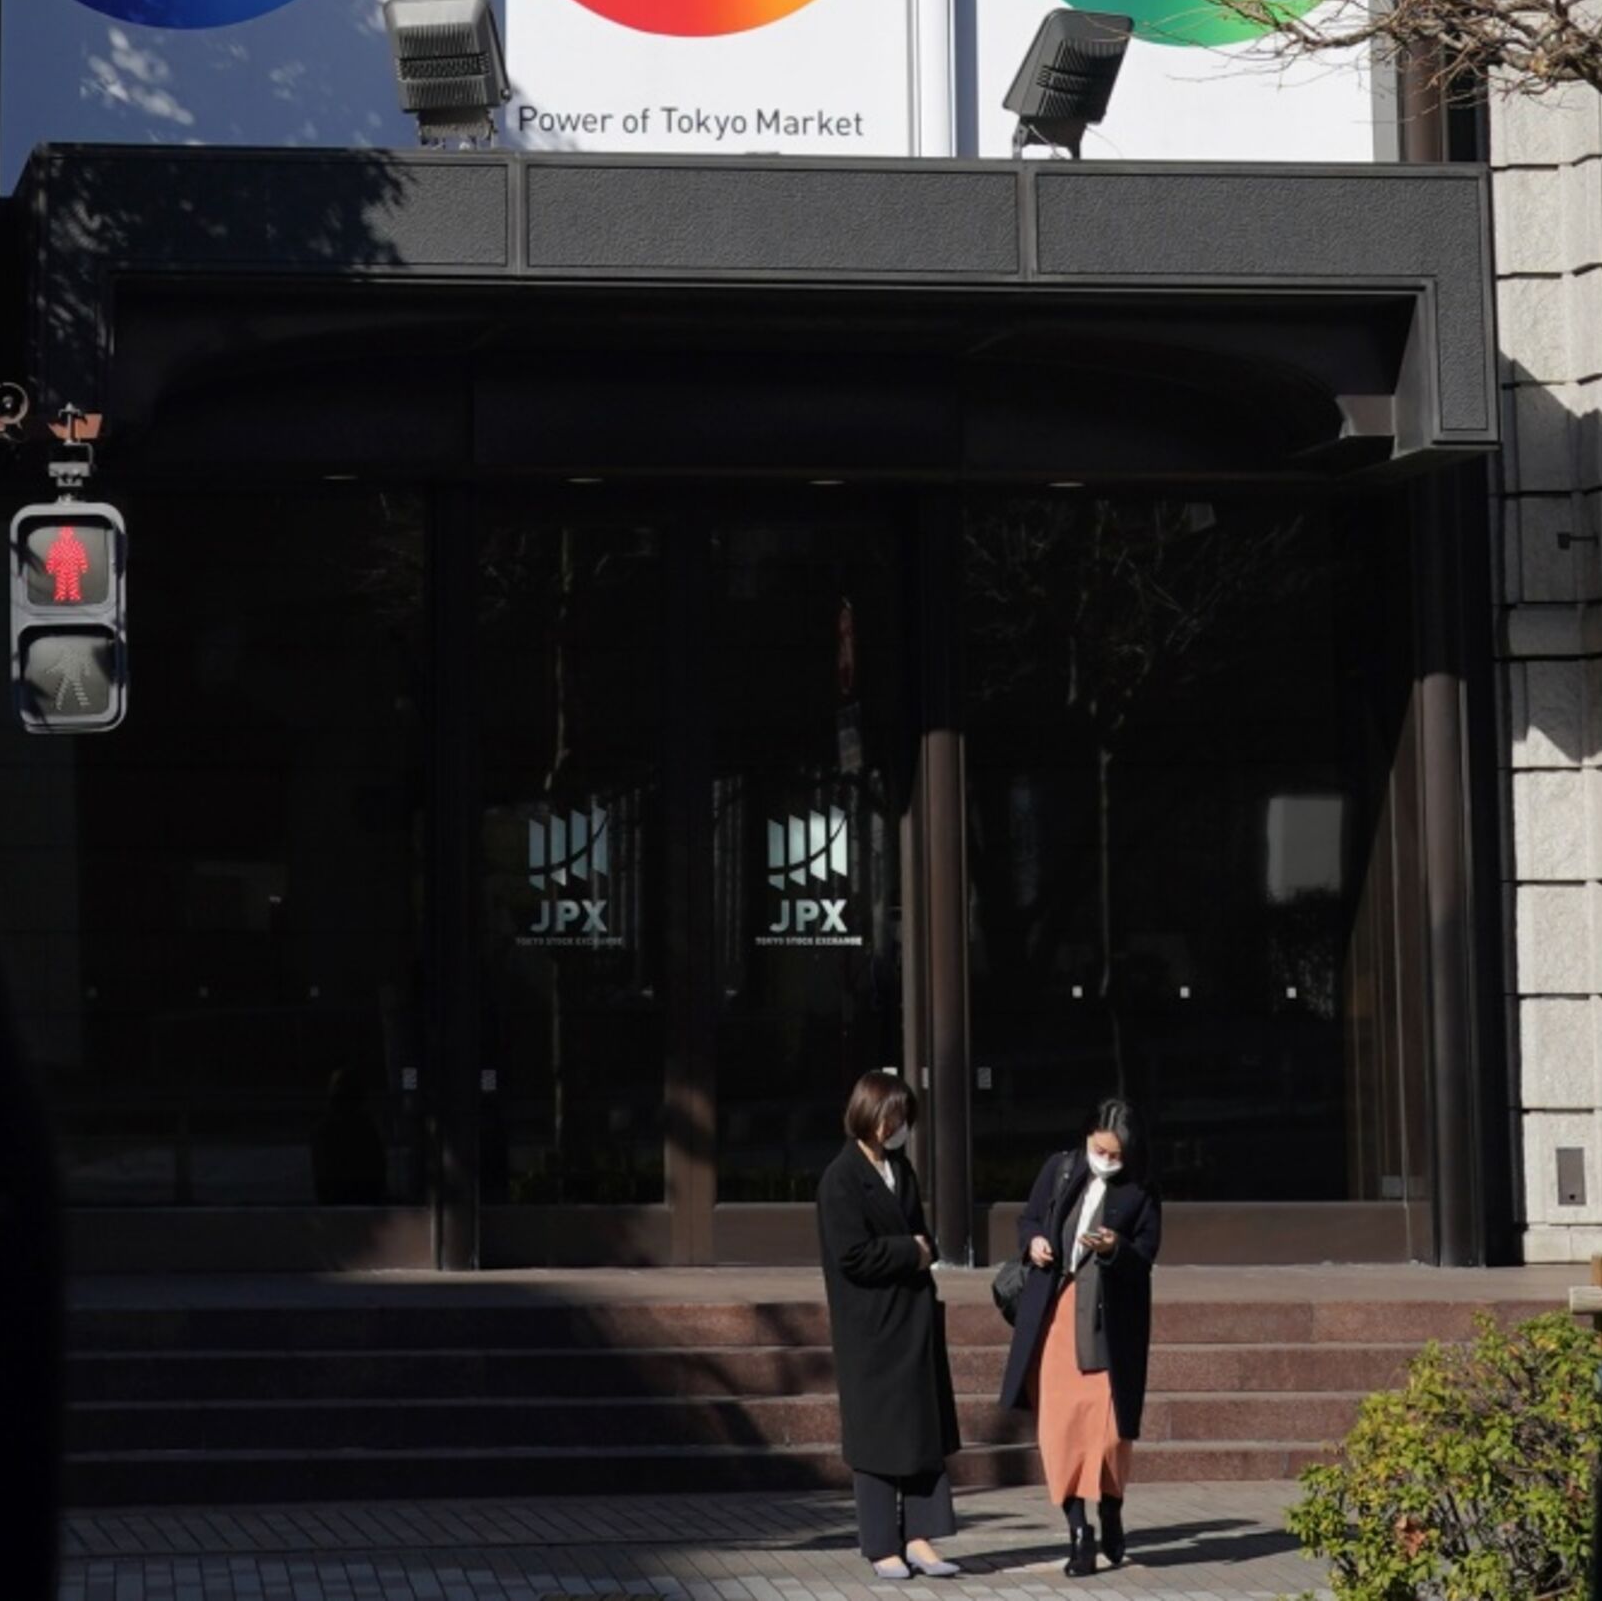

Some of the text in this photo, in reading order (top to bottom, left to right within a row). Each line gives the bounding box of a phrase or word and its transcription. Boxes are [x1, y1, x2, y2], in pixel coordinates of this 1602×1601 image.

[517, 106, 864, 140] Power of Tokyo Market
[530, 899, 608, 933] JPX
[769, 899, 848, 933] JPX
